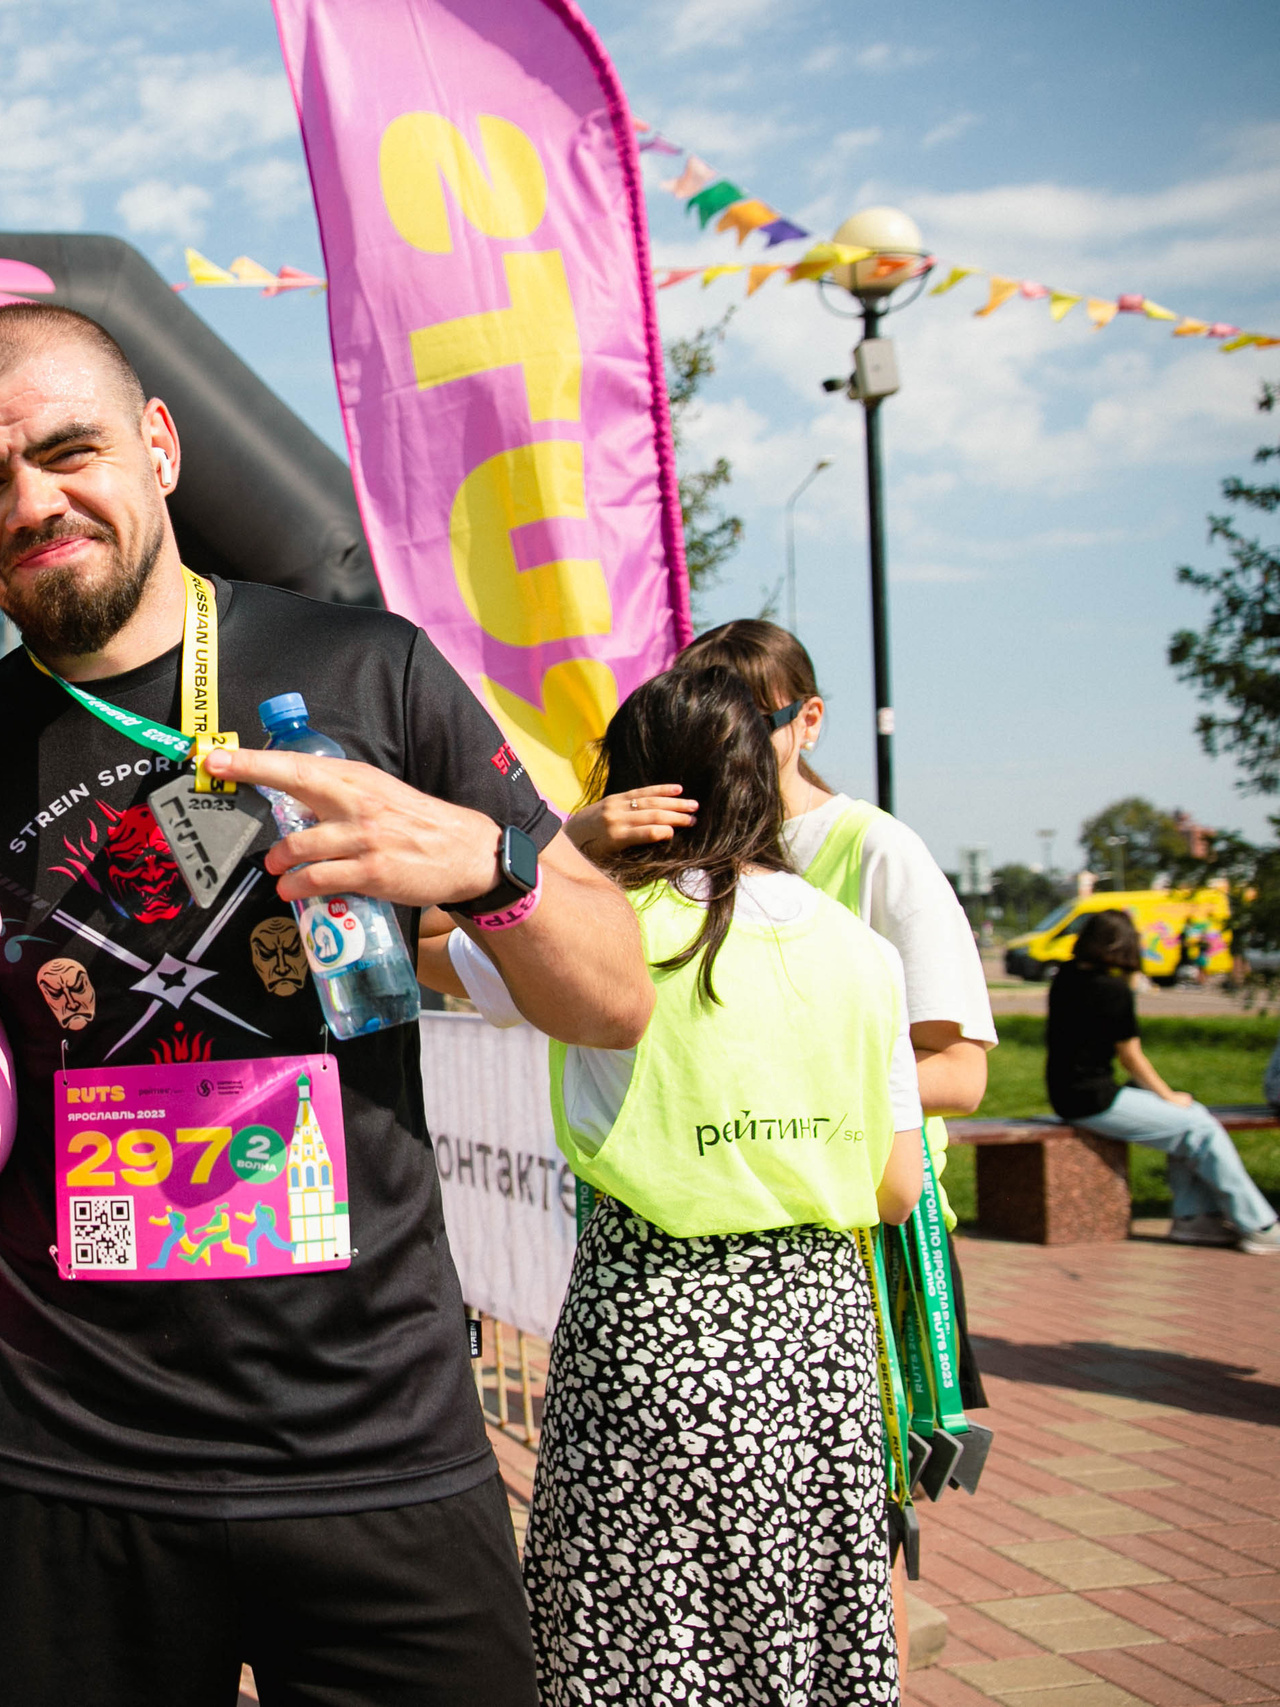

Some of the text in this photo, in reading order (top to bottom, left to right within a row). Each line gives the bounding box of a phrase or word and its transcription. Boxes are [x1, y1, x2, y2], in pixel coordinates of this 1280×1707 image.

[190, 574, 209, 645] RUSSIAN
[195, 649, 208, 711] URBAN
[142, 728, 176, 746] 2023
[9, 783, 90, 853] STREIN
[188, 799, 236, 812] 2023
[67, 1085, 125, 1105] RUTS
[68, 1109, 166, 1122] ЯРОСЛАВЛЬ 2023
[66, 1126, 232, 1187] 297
[236, 1159, 278, 1173] ВОЛНА
[246, 1135, 271, 1160] 2
[434, 1133, 577, 1218] онтакте
[930, 1225, 942, 1247] ПО
[932, 1311, 948, 1352] RUTS
[880, 1362, 894, 1416] SERIES
[911, 1355, 924, 1394] RUTS
[939, 1353, 954, 1388] 2023
